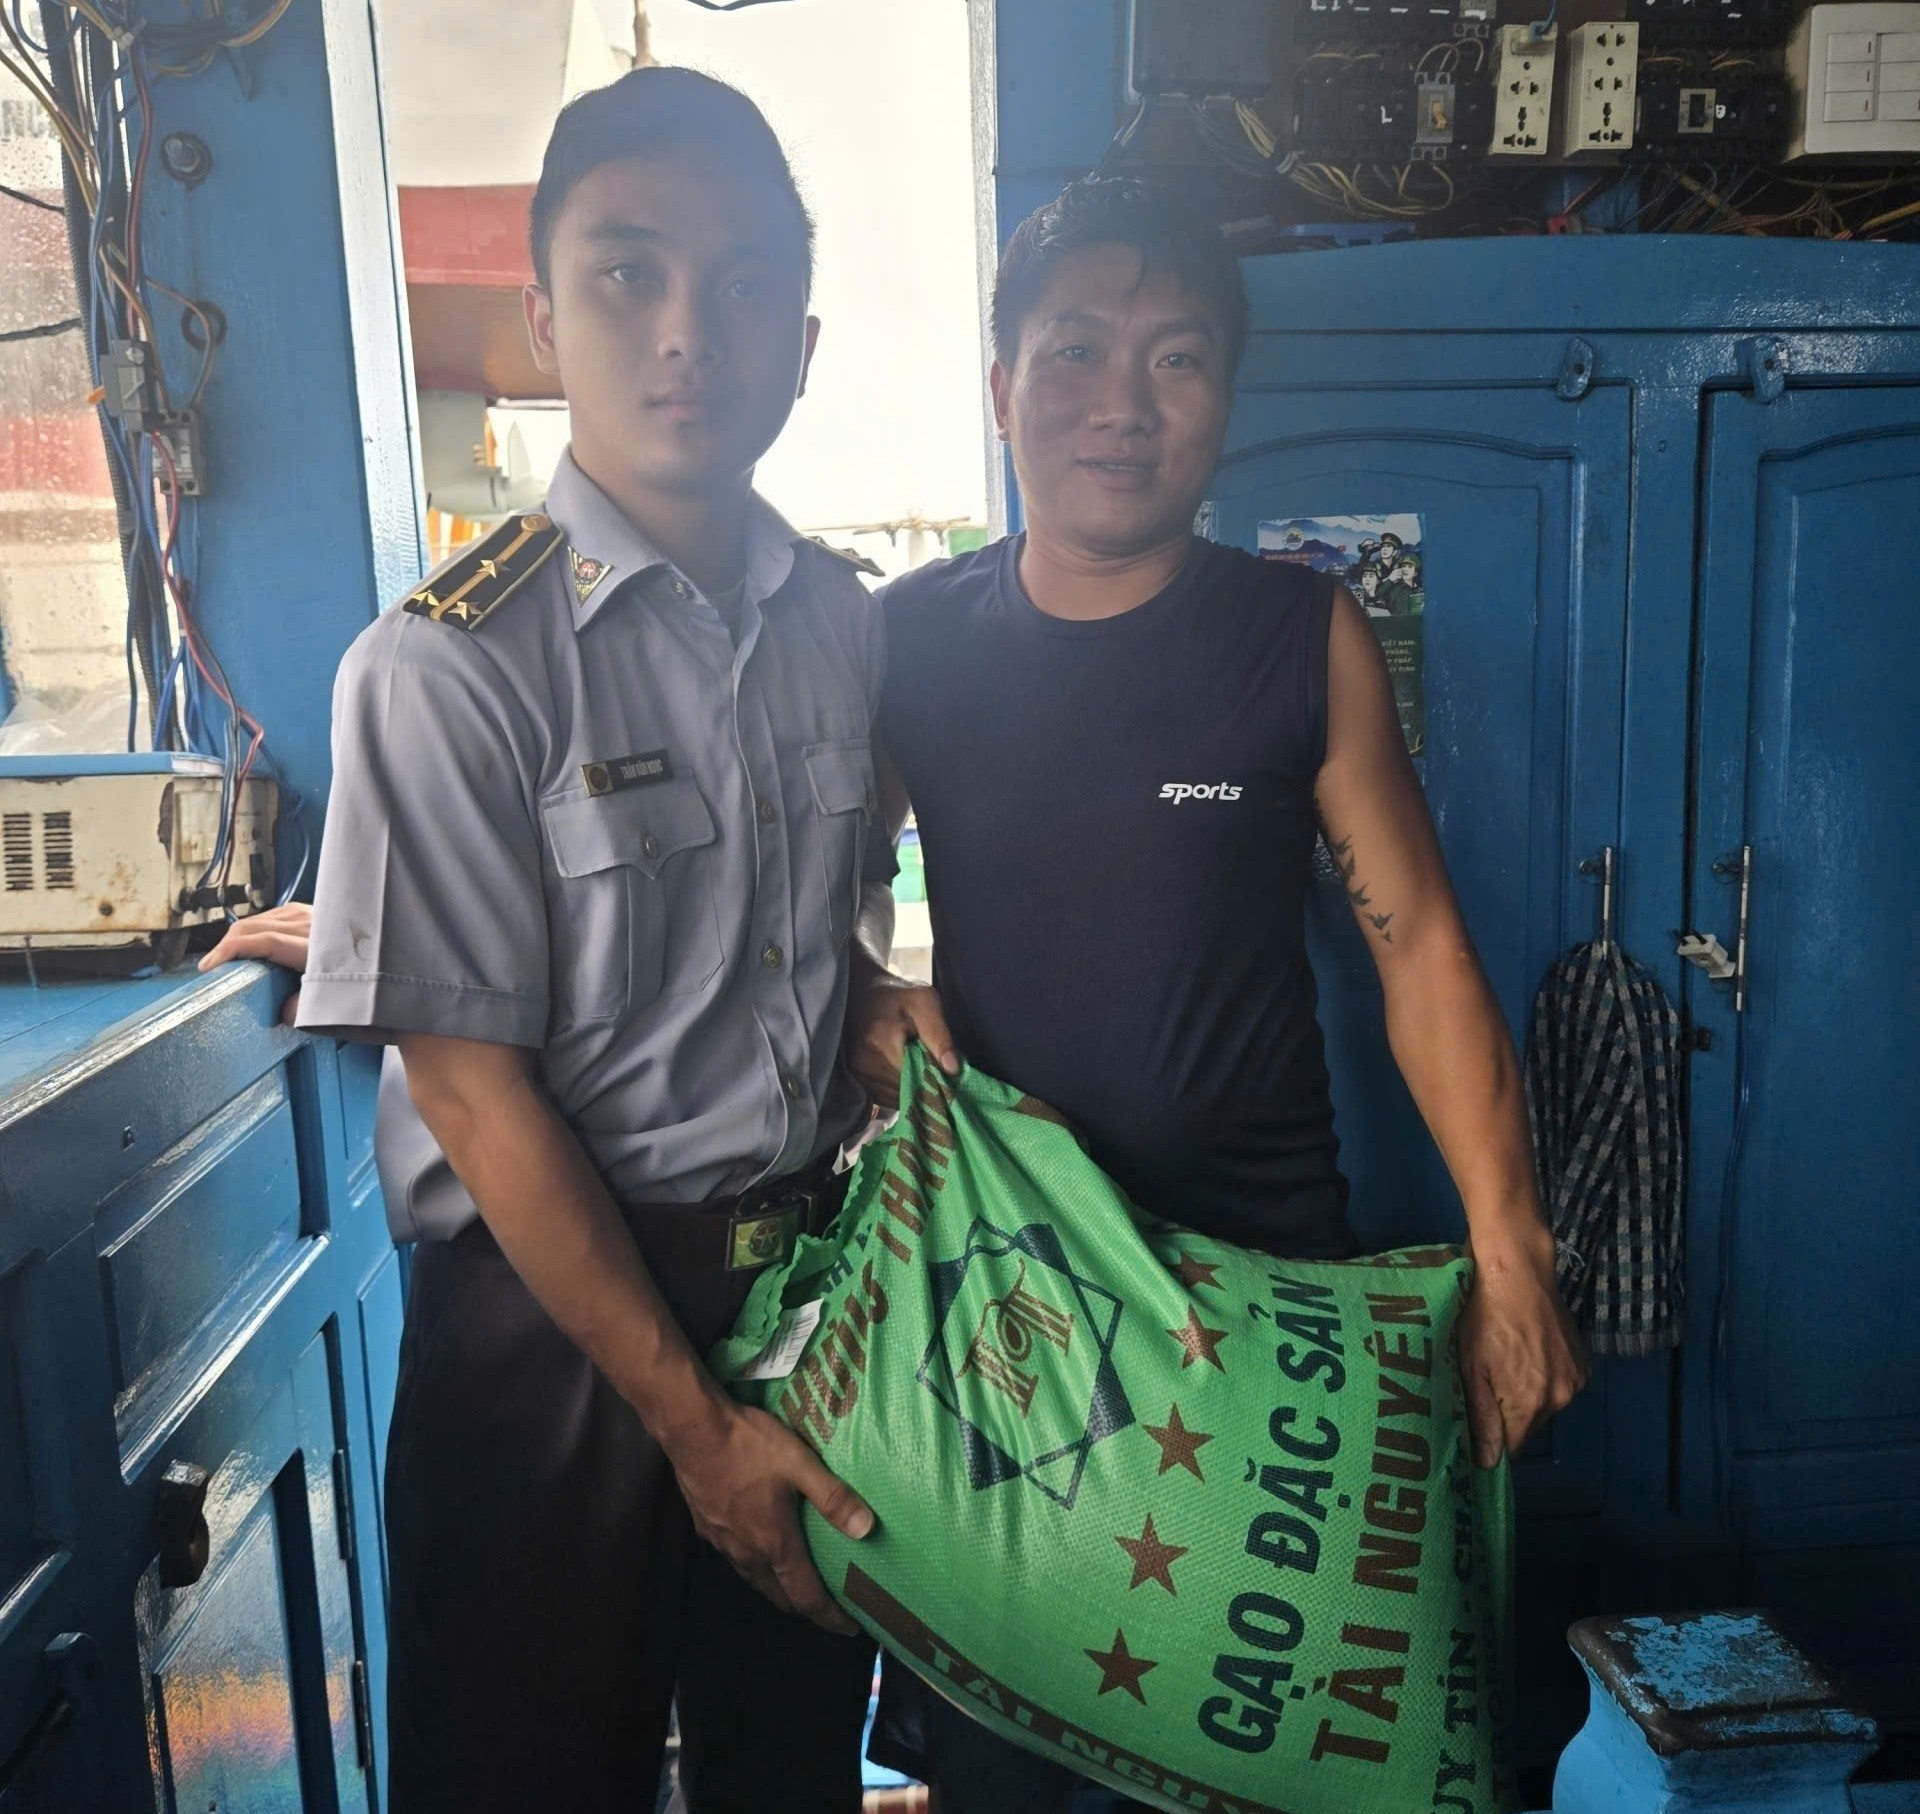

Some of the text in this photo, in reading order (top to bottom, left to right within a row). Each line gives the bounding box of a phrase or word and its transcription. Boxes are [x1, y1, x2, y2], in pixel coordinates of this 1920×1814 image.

[1159, 782, 1243, 805] sports
[1198, 1273, 1350, 1753] GẠO ĐẶC SẢN
[1310, 1292, 1432, 1764] TÀI NGUYÊN
